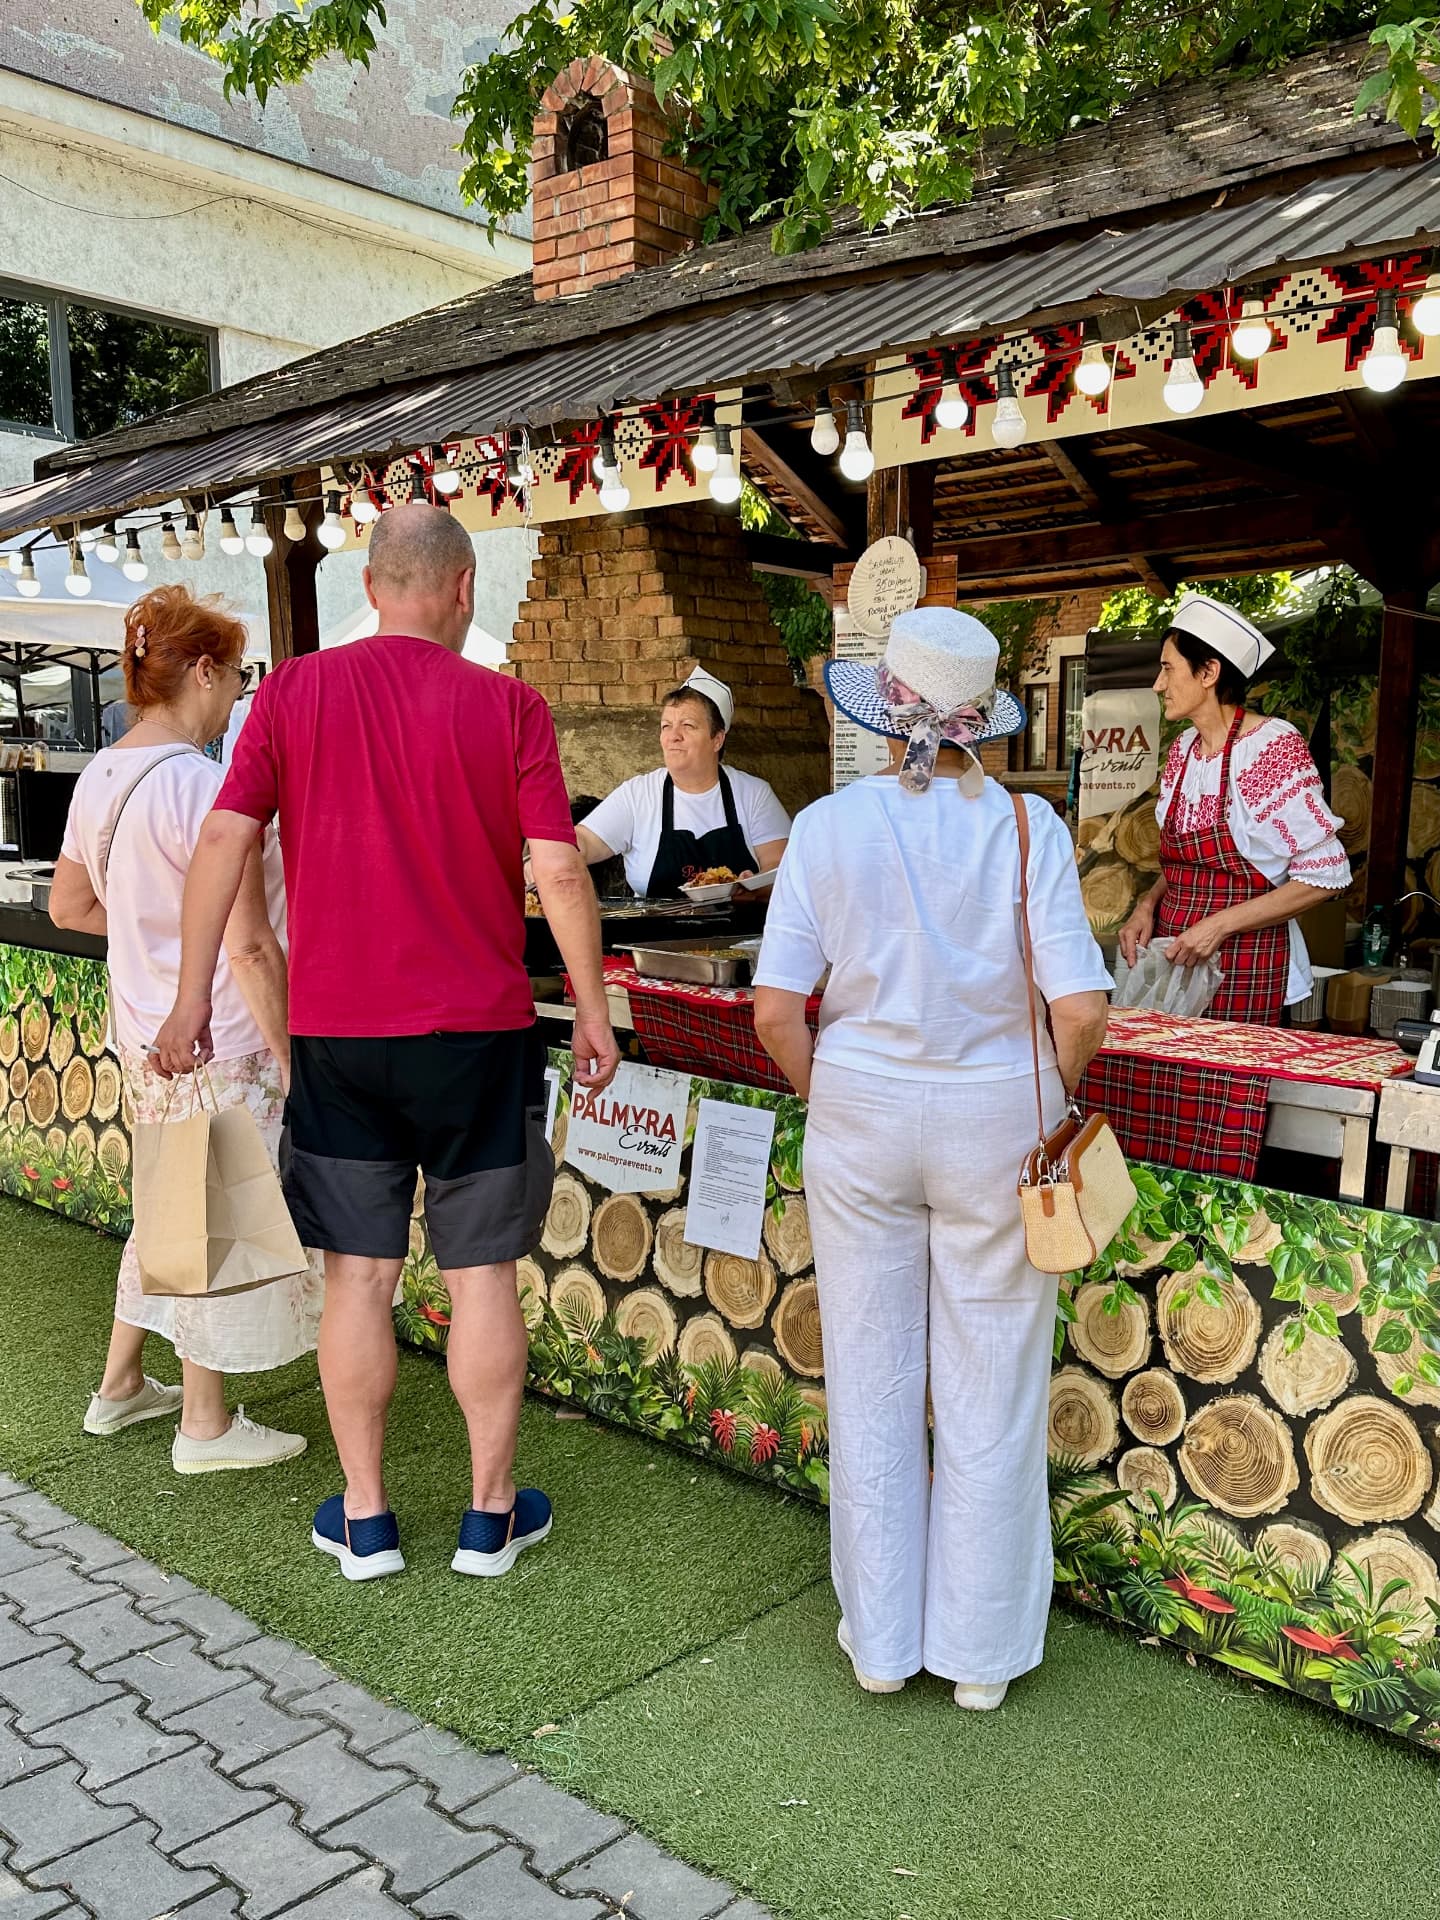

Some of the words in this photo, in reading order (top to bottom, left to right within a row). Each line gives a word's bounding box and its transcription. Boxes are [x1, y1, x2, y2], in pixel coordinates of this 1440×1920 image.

[1081, 724, 1151, 754] YRA
[1080, 745, 1152, 773] Events
[1081, 781, 1136, 790] aevents.ro
[572, 1092, 677, 1141] PALMYRA
[618, 1124, 677, 1158] Events
[577, 1147, 663, 1174] www.palmyraevents.ro
